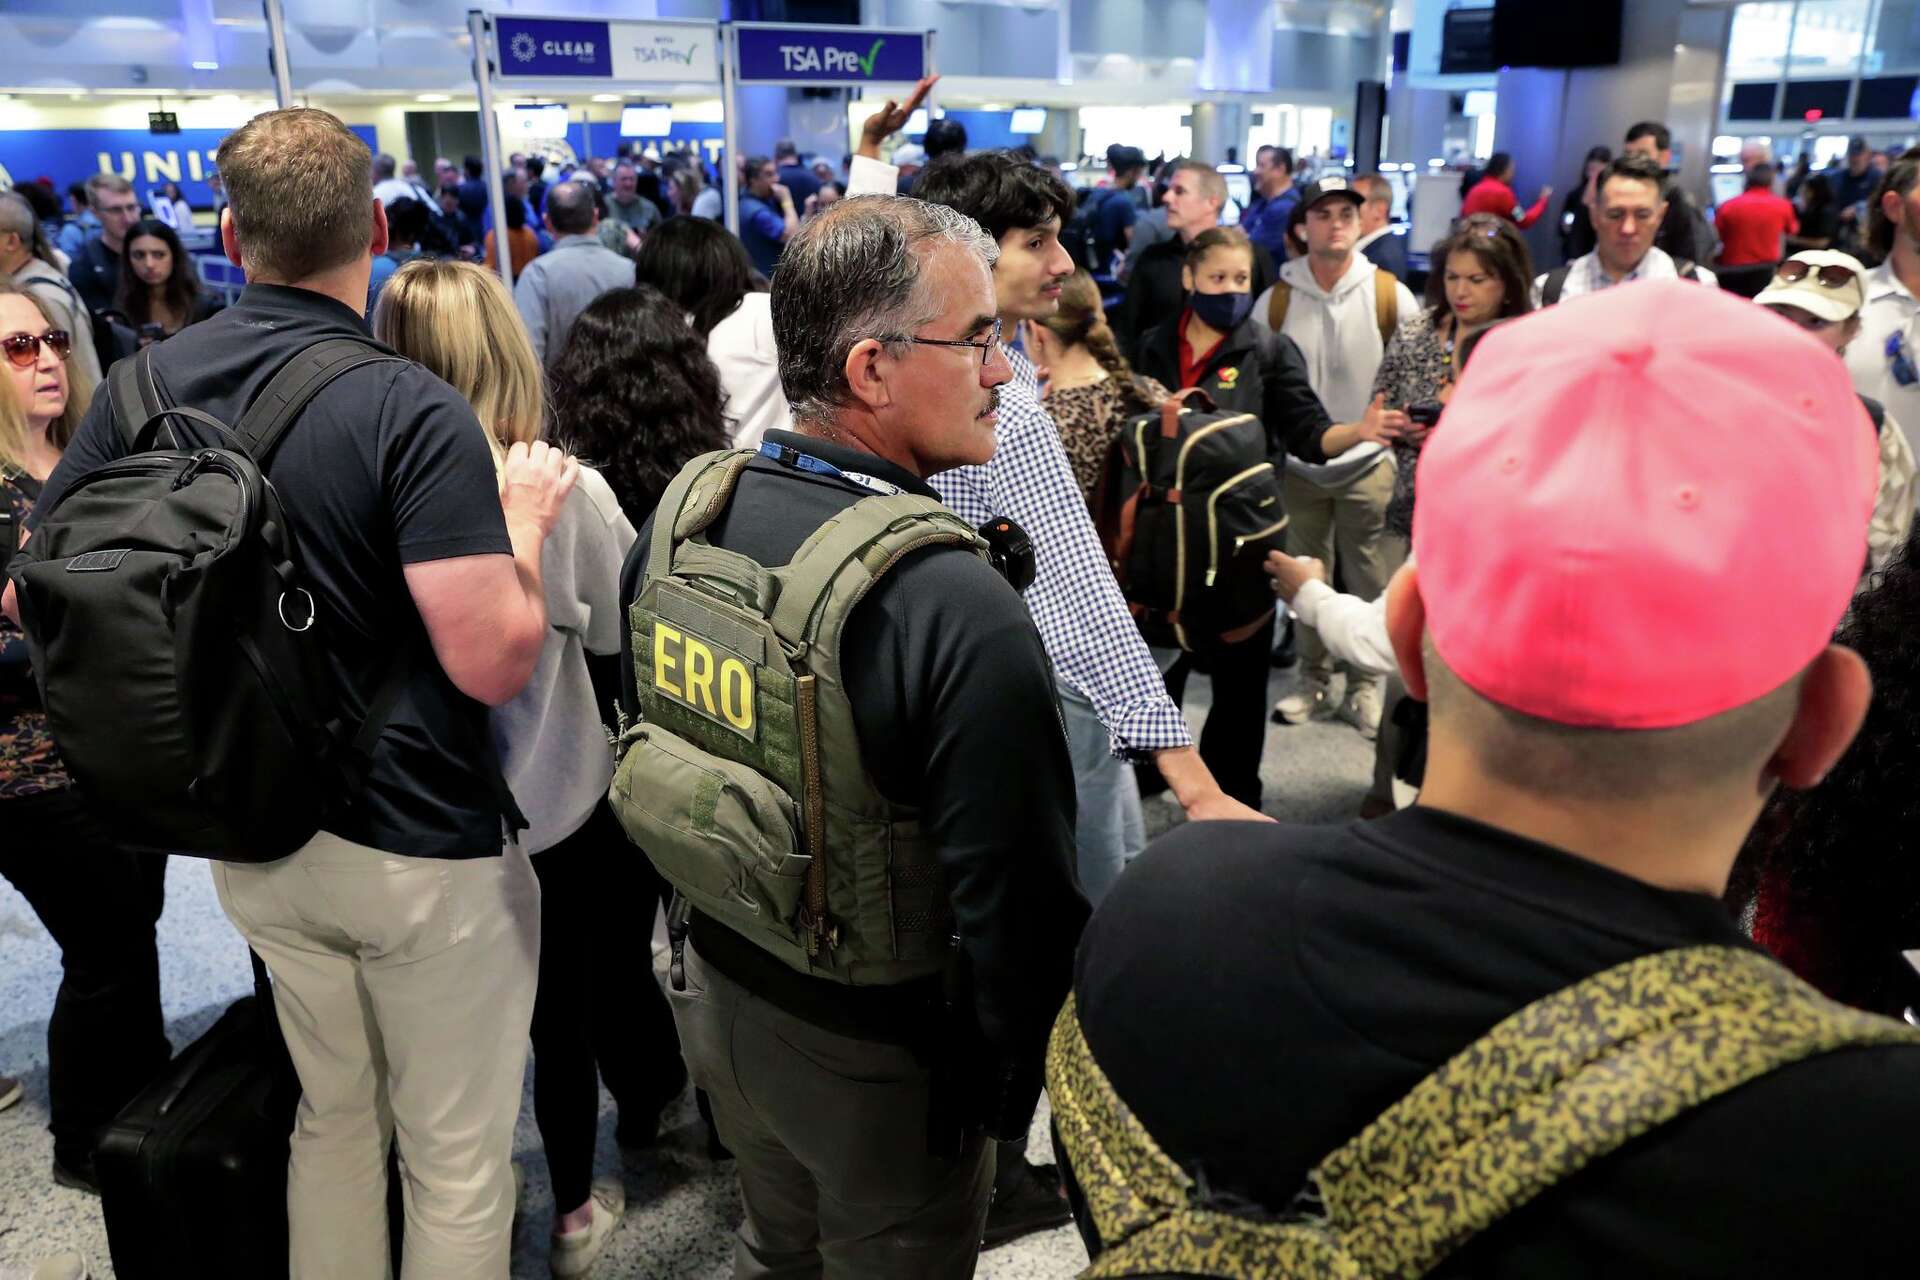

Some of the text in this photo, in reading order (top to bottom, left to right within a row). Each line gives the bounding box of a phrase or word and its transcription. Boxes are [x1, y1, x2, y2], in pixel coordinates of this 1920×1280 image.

[542, 41, 595, 56] CLEAR
[633, 47, 658, 62] TSA
[779, 45, 859, 73] TSA Pre
[655, 621, 753, 730] ERO
